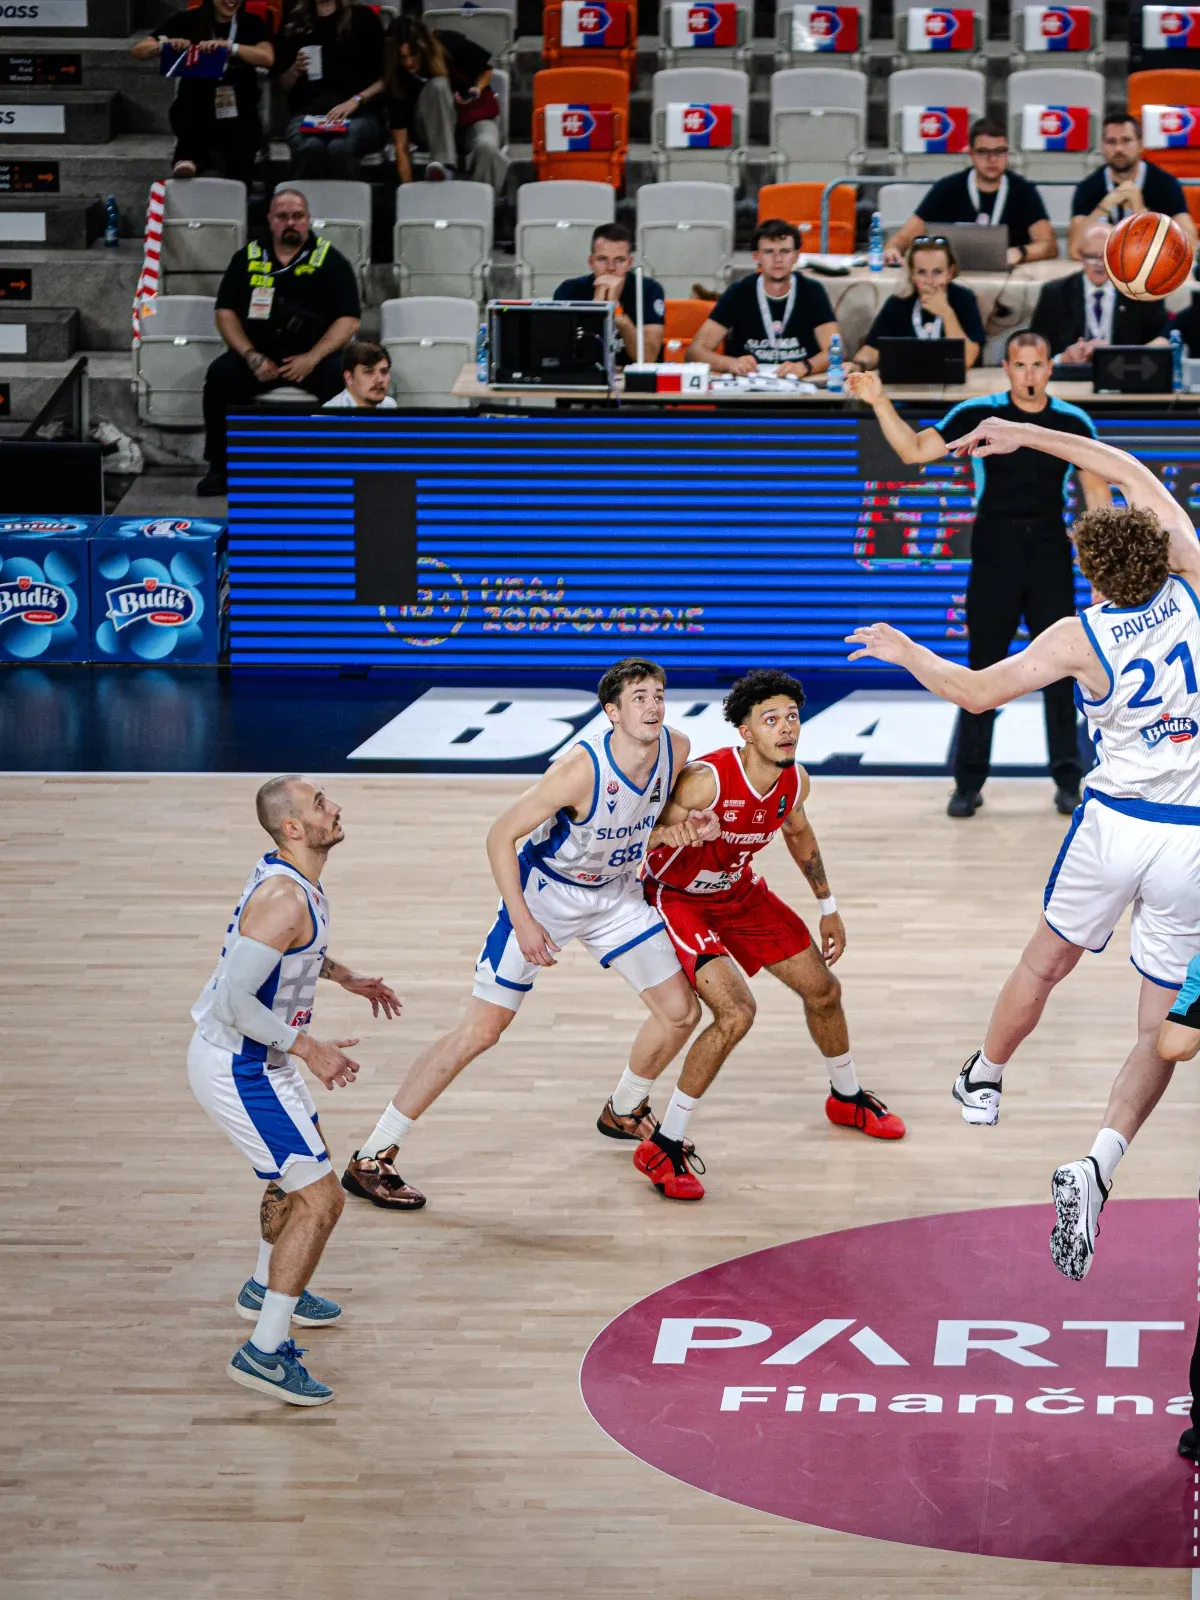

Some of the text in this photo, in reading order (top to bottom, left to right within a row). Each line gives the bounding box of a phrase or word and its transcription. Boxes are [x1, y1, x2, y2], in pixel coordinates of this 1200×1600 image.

[690, 375, 701, 390] 4
[118, 587, 186, 614] Budiš
[1111, 598, 1181, 643] PAVELKA
[1120, 641, 1199, 709] 21
[1146, 719, 1192, 742] Budiš
[608, 841, 644, 868] 88
